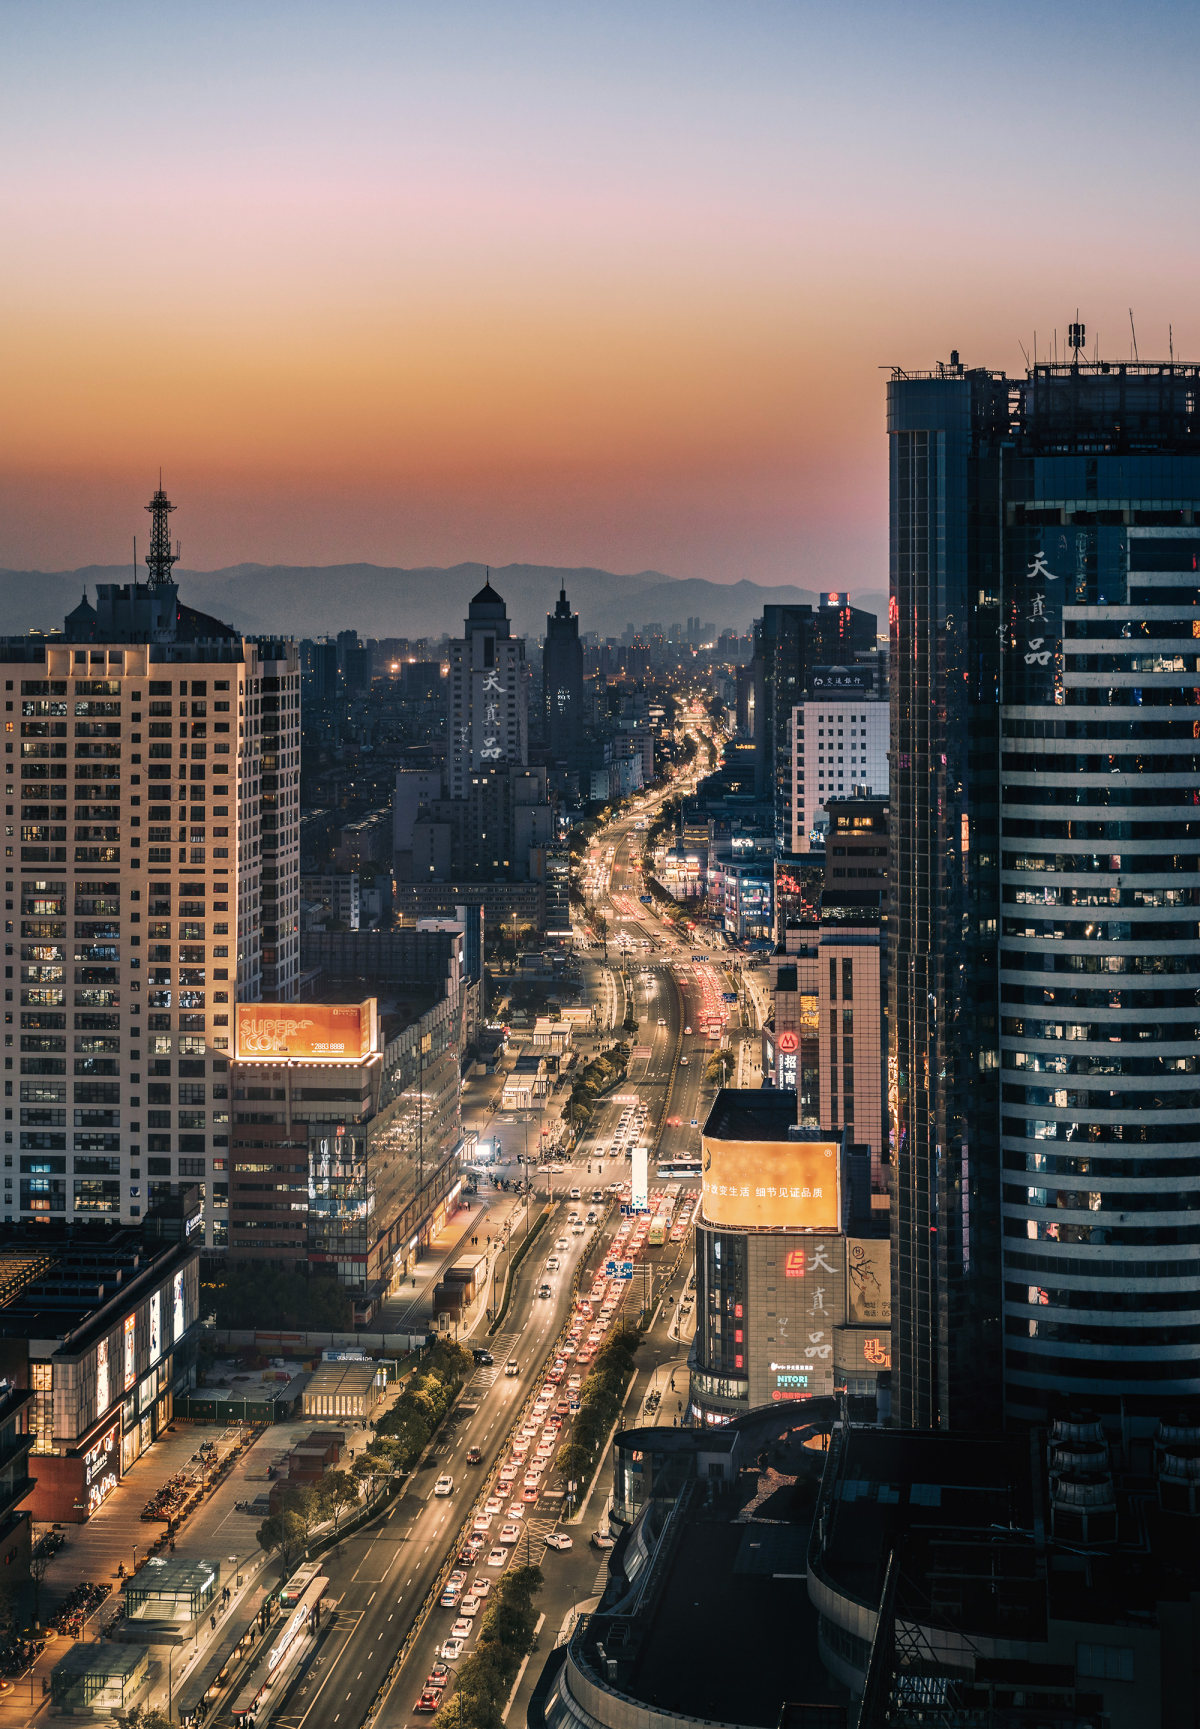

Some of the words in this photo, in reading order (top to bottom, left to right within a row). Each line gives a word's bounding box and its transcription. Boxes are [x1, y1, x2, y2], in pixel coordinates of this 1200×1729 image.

[240, 1019, 298, 1036] SUPER
[240, 1034, 287, 1051] ICON
[784, 1054, 797, 1090] 招商
[755, 1187, 823, 1198] 细节见证品质
[777, 1375, 808, 1383] NITORI
